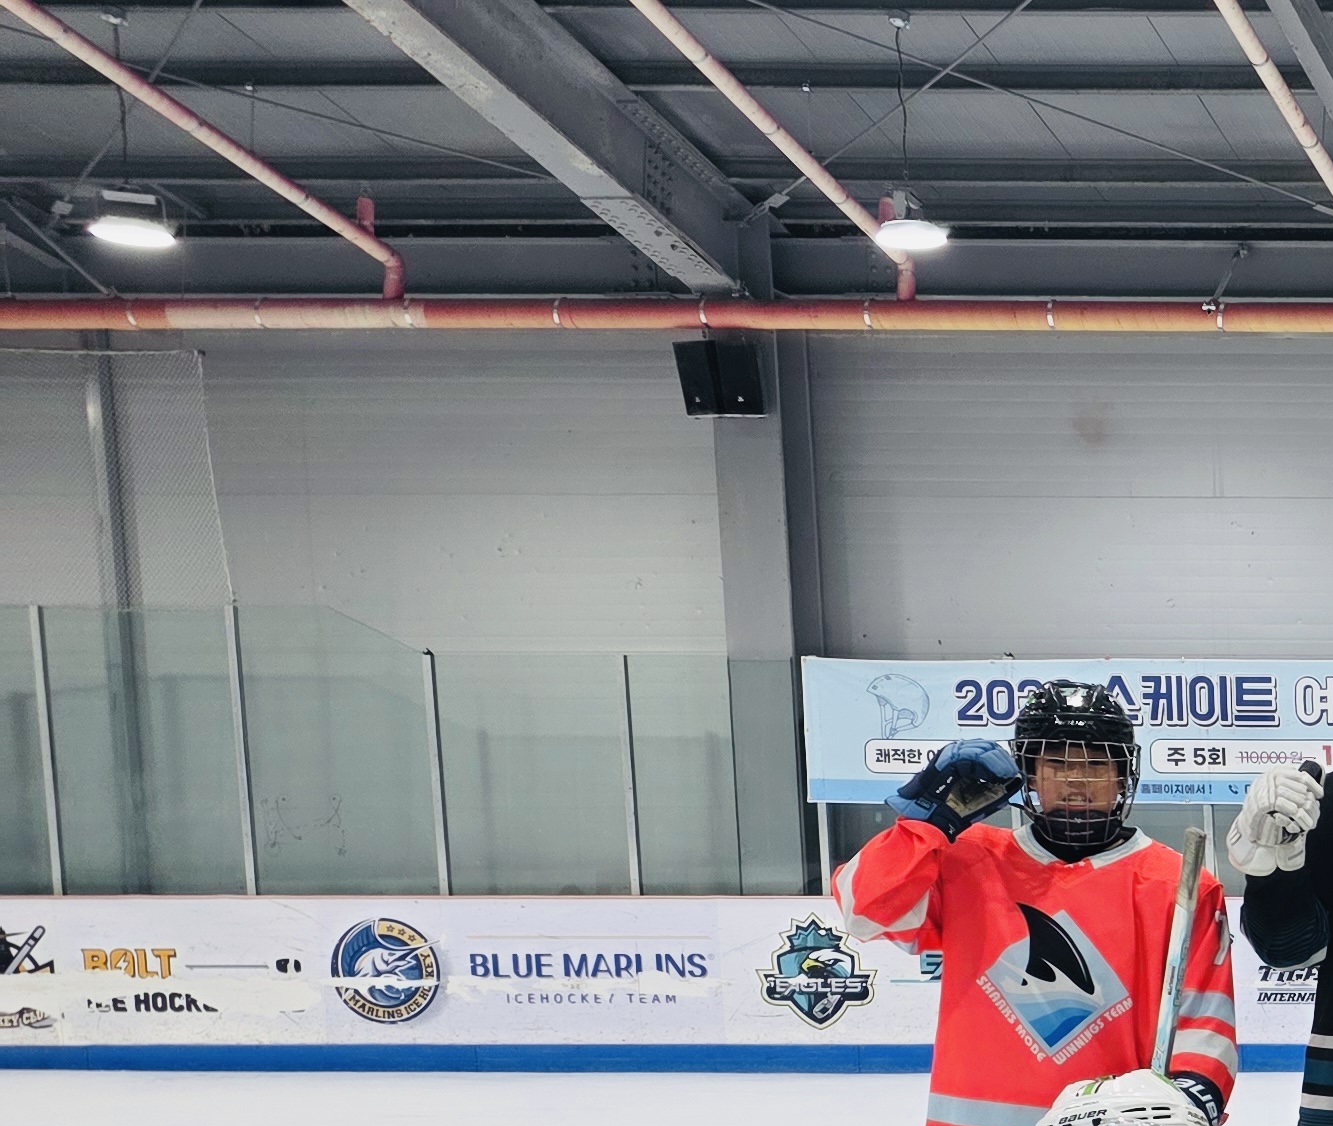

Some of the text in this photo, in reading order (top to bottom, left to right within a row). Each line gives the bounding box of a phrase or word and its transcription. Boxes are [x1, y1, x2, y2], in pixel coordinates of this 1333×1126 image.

[875, 747, 923, 765] 쾌적한
[1166, 747, 1188, 767] 주
[1193, 747, 1227, 767] 5회
[81, 948, 177, 979] BOLT
[469, 953, 553, 979] BLUE
[773, 978, 864, 994] EAGLES
[626, 992, 677, 1004] TEAM
[1257, 992, 1318, 1005] INTERNA
[975, 975, 1048, 1063] SHARKS MODE
[1051, 997, 1134, 1066] WINNINGS TEAM
[1057, 1107, 1108, 1125] BAUER
